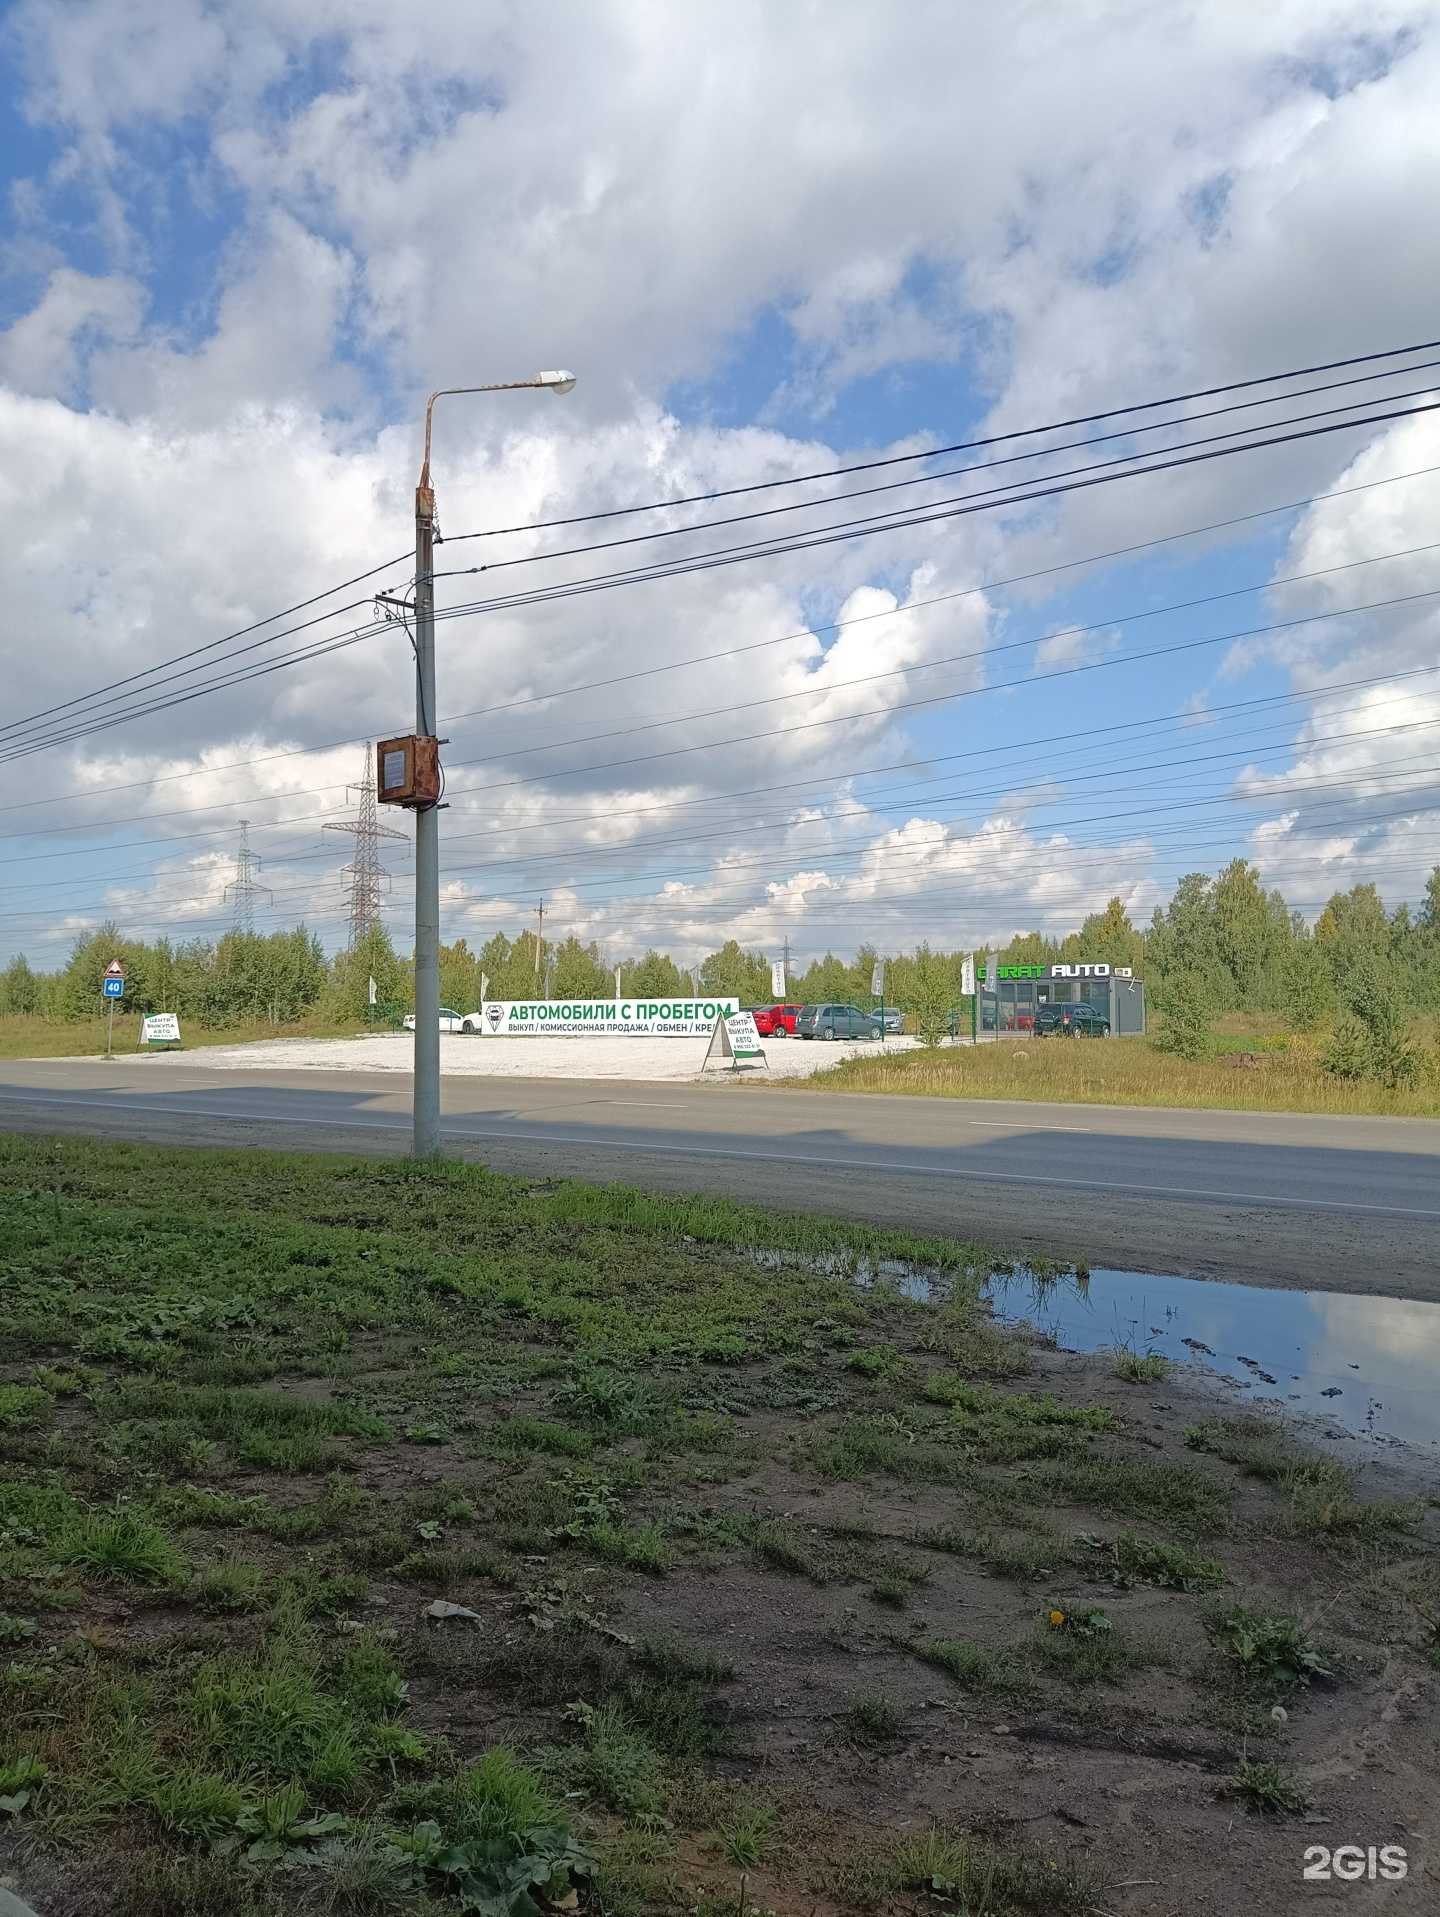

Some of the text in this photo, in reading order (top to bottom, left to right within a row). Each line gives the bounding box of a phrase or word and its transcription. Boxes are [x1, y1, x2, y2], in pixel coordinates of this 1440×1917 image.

[1051, 964, 1110, 977] AUTO
[108, 983, 120, 992] 40
[508, 1003, 731, 1020] АВТОМОБИЛИ С ПРОБЕГОМ
[508, 1023, 535, 1032] ВЫКУП
[540, 1023, 605, 1032] КОМИССИОННАЯ
[607, 1023, 649, 1033] ПРОДАЖА
[656, 1023, 688, 1032] ОБМЕН
